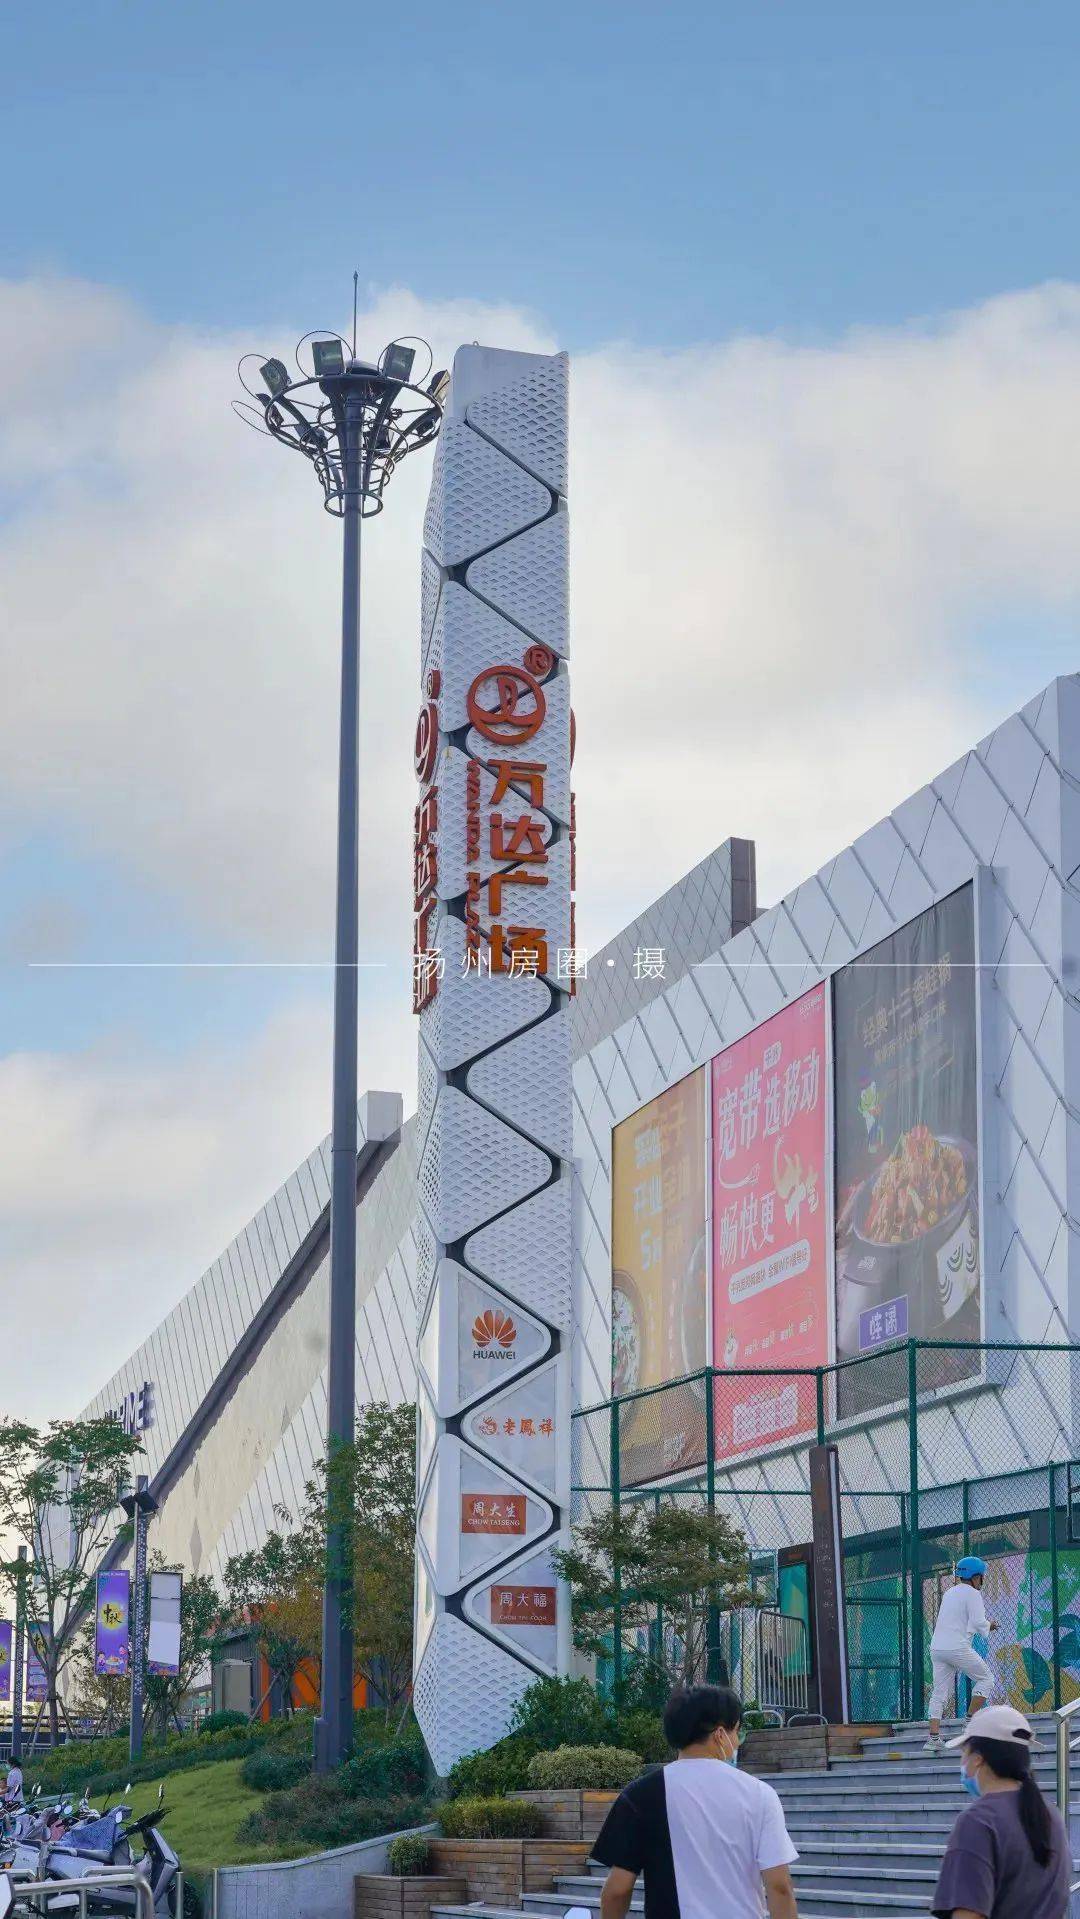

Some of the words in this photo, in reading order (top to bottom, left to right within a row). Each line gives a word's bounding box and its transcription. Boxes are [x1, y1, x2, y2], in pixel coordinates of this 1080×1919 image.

[488, 758, 549, 975] 万达广场
[718, 1047, 820, 1161] 宽带选移动
[472, 1351, 517, 1360] HUAWEI
[502, 1418, 555, 1437] 老鳳祥
[472, 1501, 517, 1518] 周大生
[499, 1591, 548, 1608] 周大福
